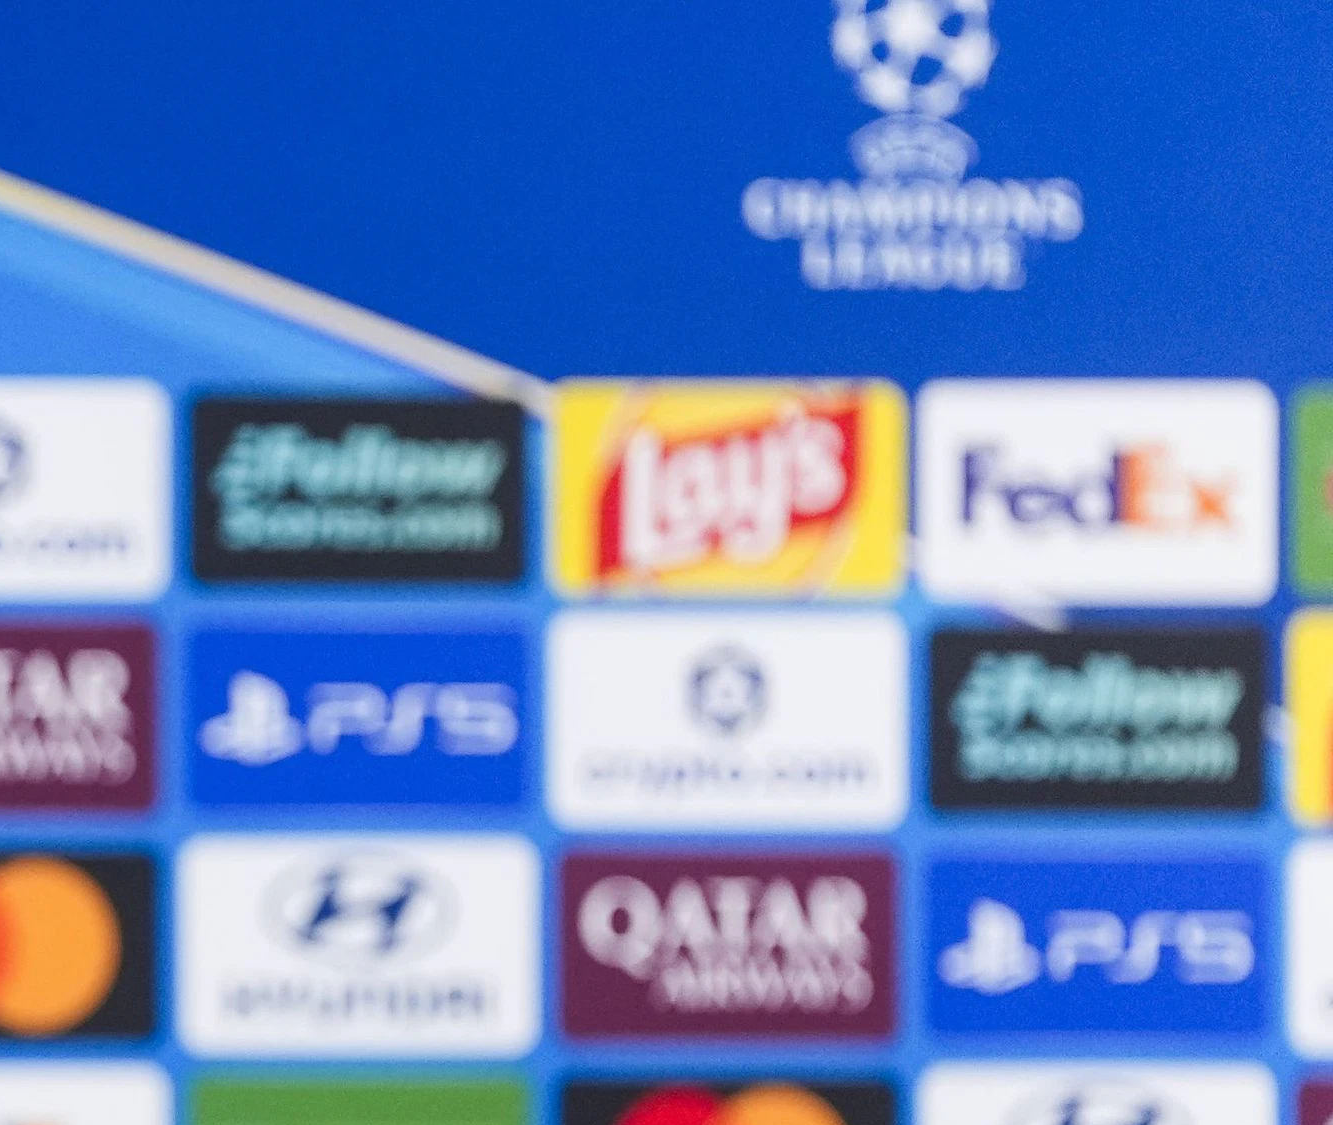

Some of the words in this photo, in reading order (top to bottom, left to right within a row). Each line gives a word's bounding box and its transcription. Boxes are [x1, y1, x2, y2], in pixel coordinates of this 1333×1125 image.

[742, 178, 1083, 240] CHAMPIONS
[800, 237, 1025, 291] LEAGUE
[621, 403, 847, 565] Lay's
[961, 444, 1235, 530] FedEx
[307, 681, 520, 757] PS5
[578, 875, 869, 980] QATAR
[1047, 909, 1255, 985] PS5
